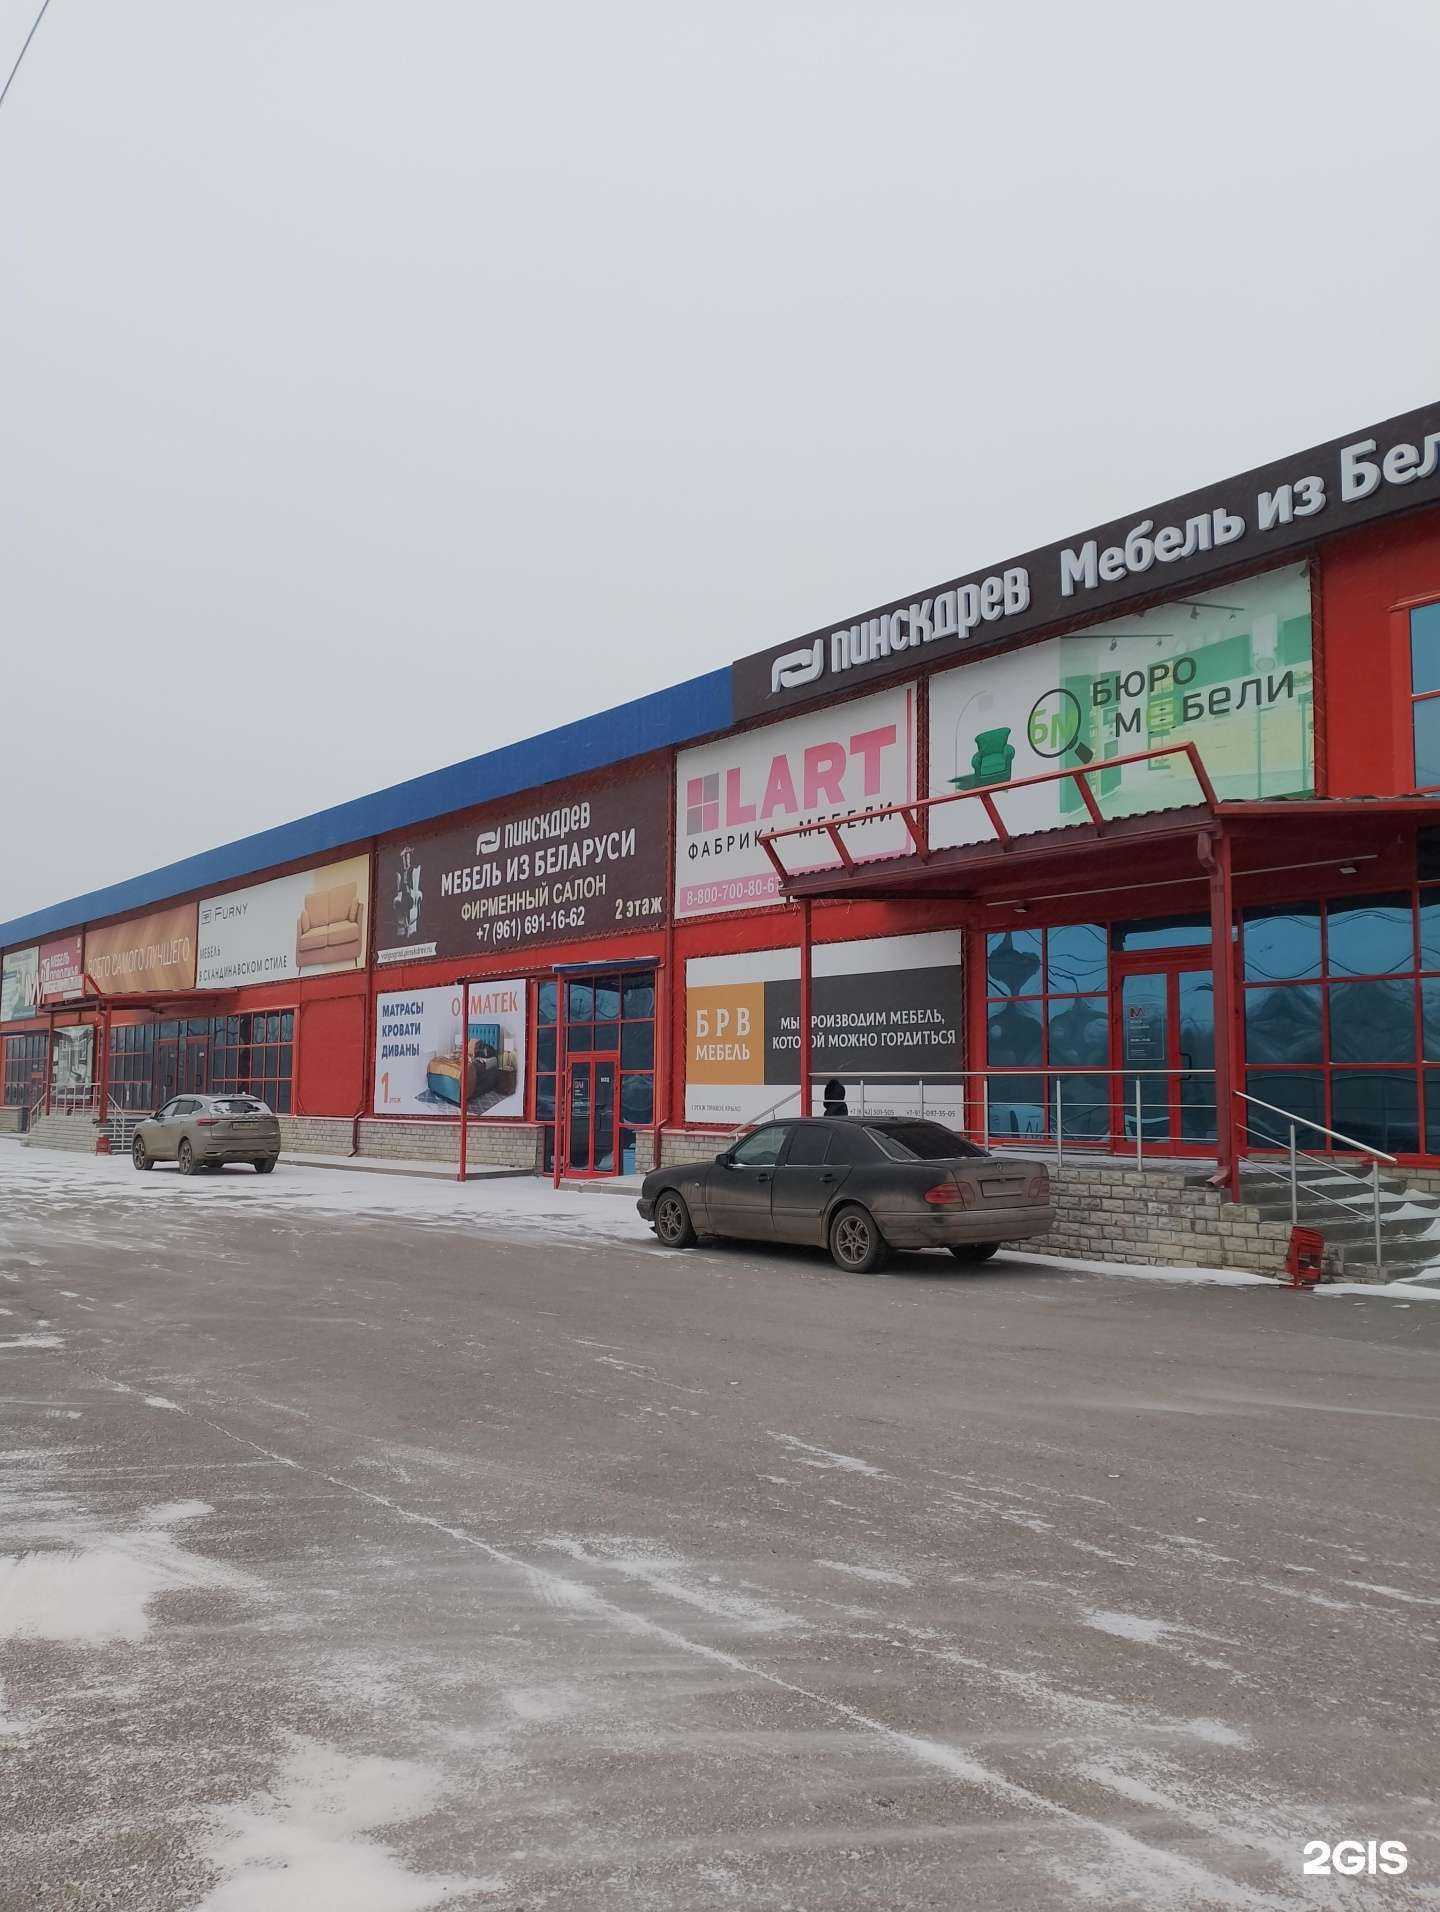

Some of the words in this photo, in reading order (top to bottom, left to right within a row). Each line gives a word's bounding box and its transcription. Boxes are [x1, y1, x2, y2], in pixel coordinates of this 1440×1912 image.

[1061, 508, 1246, 597] Мебель
[1258, 474, 1327, 531] из
[1092, 656, 1197, 707] БЮРО
[726, 724, 897, 827] LART
[441, 861, 502, 897] МЕБЕЛЬ
[506, 854, 530, 883] ИЗ
[535, 828, 636, 877] БЕЛАРУСИ
[461, 882, 549, 921] ФИРМЕННЫЙ
[553, 874, 607, 904] САЛОН
[615, 898, 623, 920] 2
[626, 896, 663, 918] этаж
[214, 903, 248, 921] FURNY
[476, 924, 490, 943] +7
[493, 918, 521, 945] (961)
[524, 906, 585, 935] 691-16-62
[146, 936, 190, 971] ЛУЧШЕГО
[204, 960, 263, 982] СКАНДИНАВСКОМ
[264, 955, 287, 971] СТИЛЕ
[382, 1001, 424, 1018] МАТРАСЫ
[452, 991, 518, 1017] ОМАТЕК
[381, 1022, 421, 1037] КРОВАТИ
[781, 1016, 800, 1031] МЫ
[811, 1012, 887, 1029] РОИЗВОДИМ
[890, 1008, 945, 1026] МЕБЕЛЬ,
[381, 1043, 420, 1060] ДИВАНЫ
[696, 1043, 750, 1061] МЕБЕЛЬ
[773, 1033, 825, 1050] КОТООЙ
[828, 1032, 878, 1048] МОЖНО
[881, 1030, 956, 1046] ГОРДИТЬСЯ
[381, 1072, 389, 1103] 1
